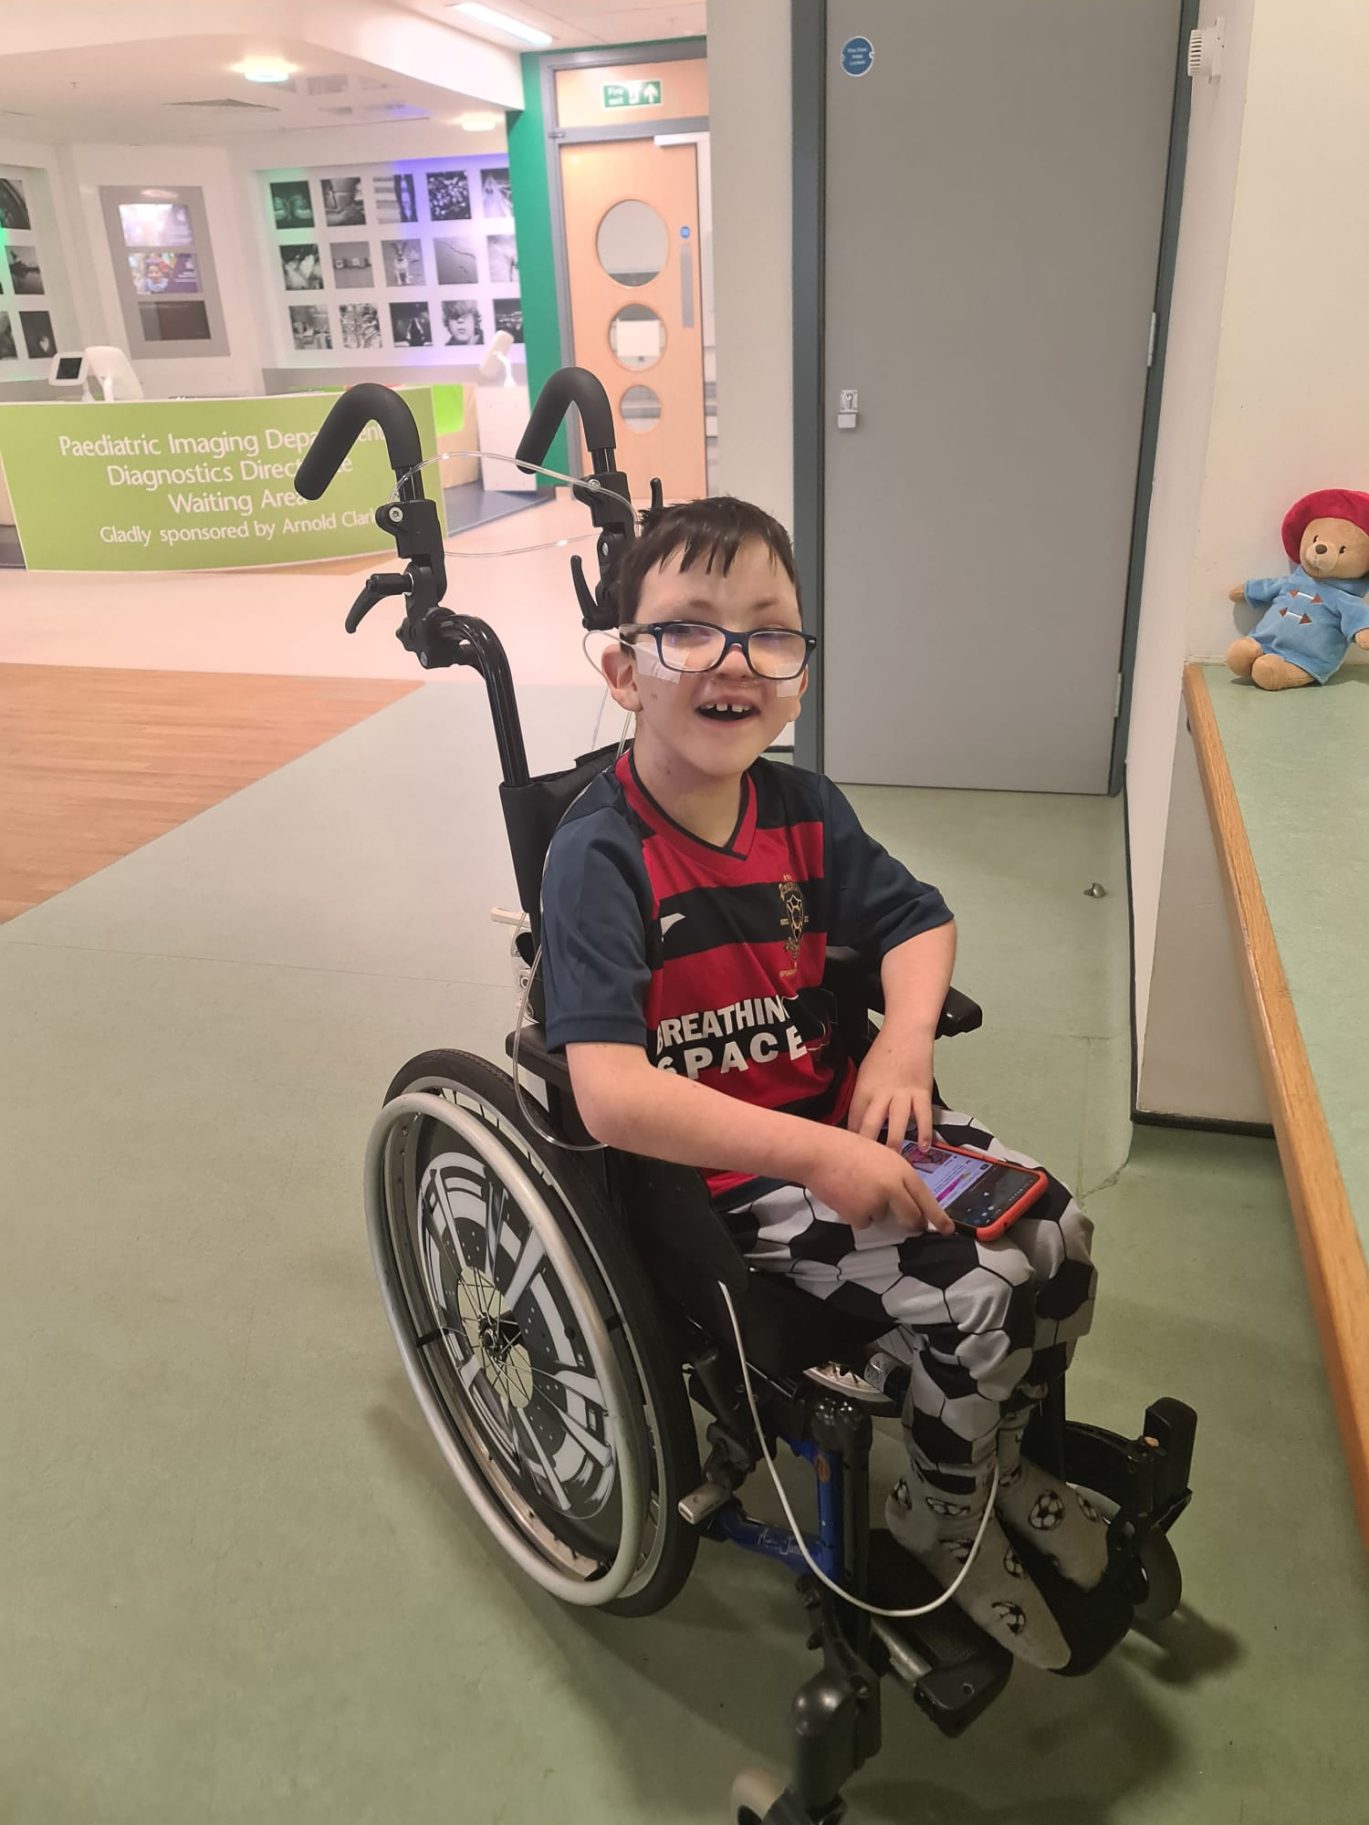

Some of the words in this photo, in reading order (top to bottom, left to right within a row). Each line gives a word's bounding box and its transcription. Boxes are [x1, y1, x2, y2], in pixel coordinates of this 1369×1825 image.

[58, 433, 162, 457] Paediatric
[167, 430, 259, 459] Imaging
[106, 462, 234, 491] Diagnostics
[167, 491, 253, 516] Waiting
[99, 525, 151, 547] Gladly
[159, 522, 249, 546] sponsored
[254, 520, 276, 540] by
[282, 514, 336, 534] Arnold
[656, 994, 791, 1056] BREATHIN
[656, 1025, 808, 1080] SPACE
